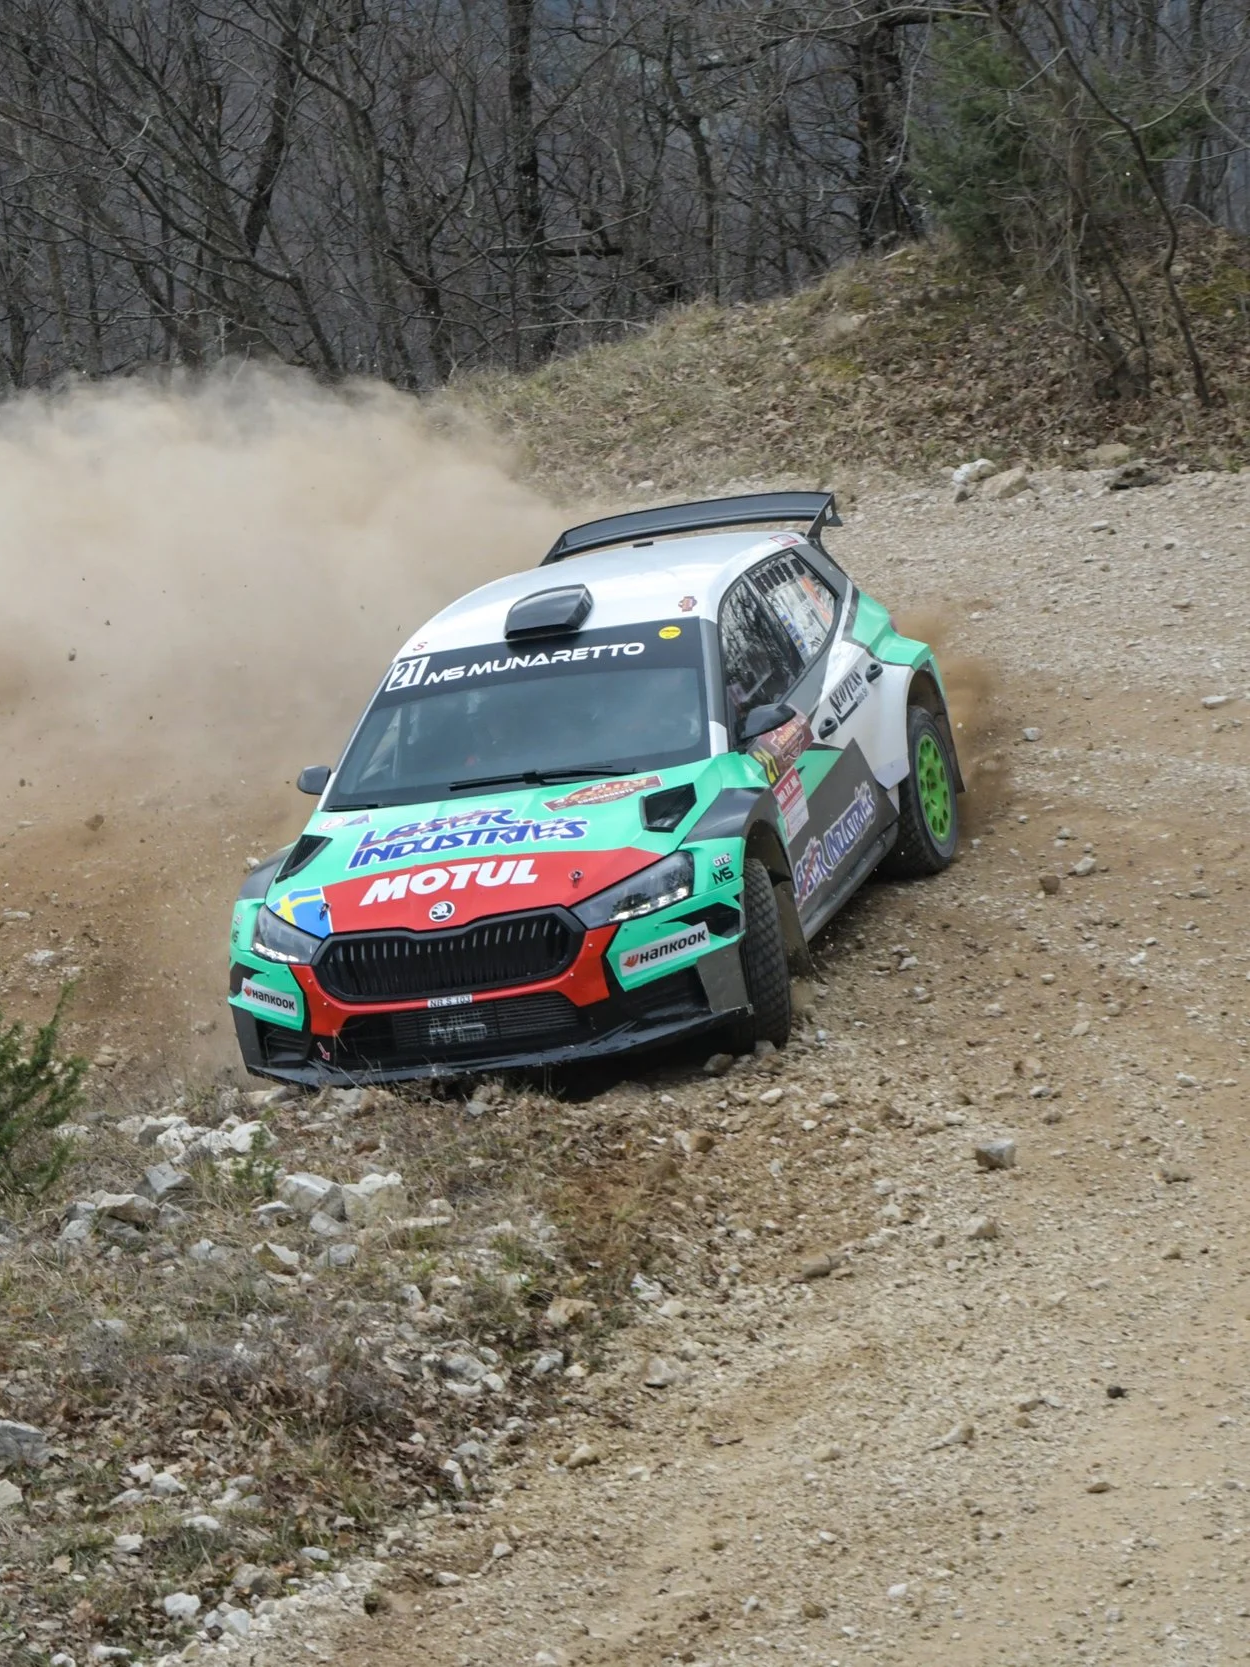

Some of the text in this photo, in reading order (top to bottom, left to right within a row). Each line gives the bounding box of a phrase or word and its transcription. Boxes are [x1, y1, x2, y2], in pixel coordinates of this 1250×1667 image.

[390, 659, 423, 689] 21
[424, 642, 645, 686] MS MUNARETTO
[753, 746, 779, 784] 21
[348, 818, 588, 869] INDUSTRIES
[359, 859, 538, 906] MOTUL
